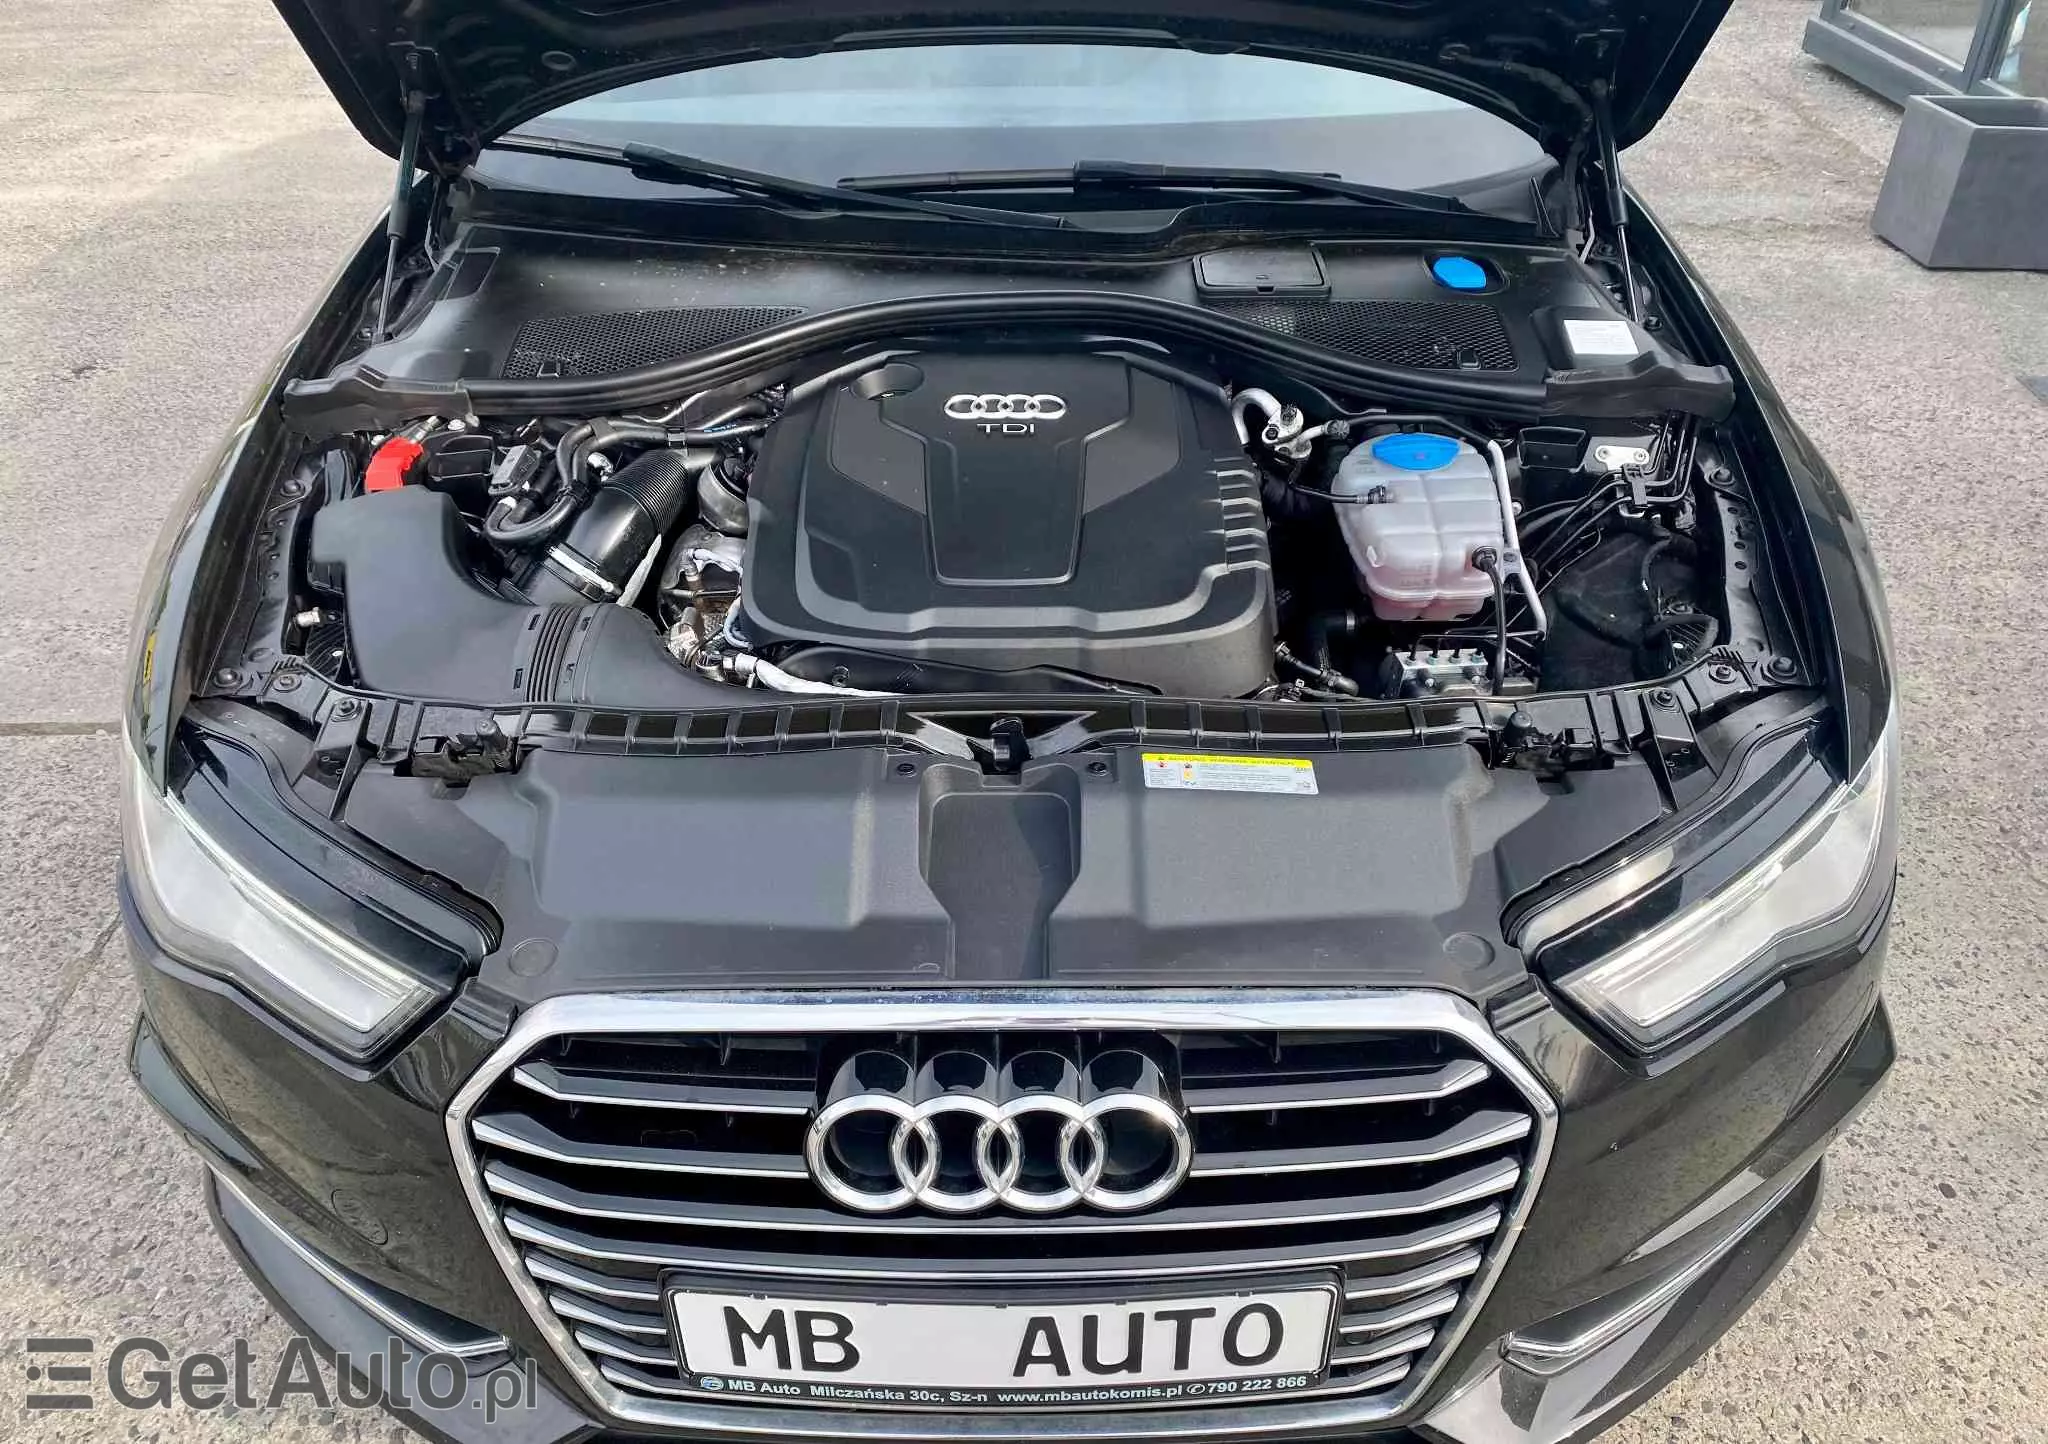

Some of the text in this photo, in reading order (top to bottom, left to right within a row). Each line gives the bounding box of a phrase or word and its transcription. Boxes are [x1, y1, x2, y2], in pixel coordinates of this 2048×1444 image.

[976, 423, 1035, 433] TDI
[723, 1303, 1285, 1377] MB AUTO
[728, 1376, 1307, 1403] MB Auto Milczańska 30c, Sz-n www.mbautokomis.pl 790 222 866
